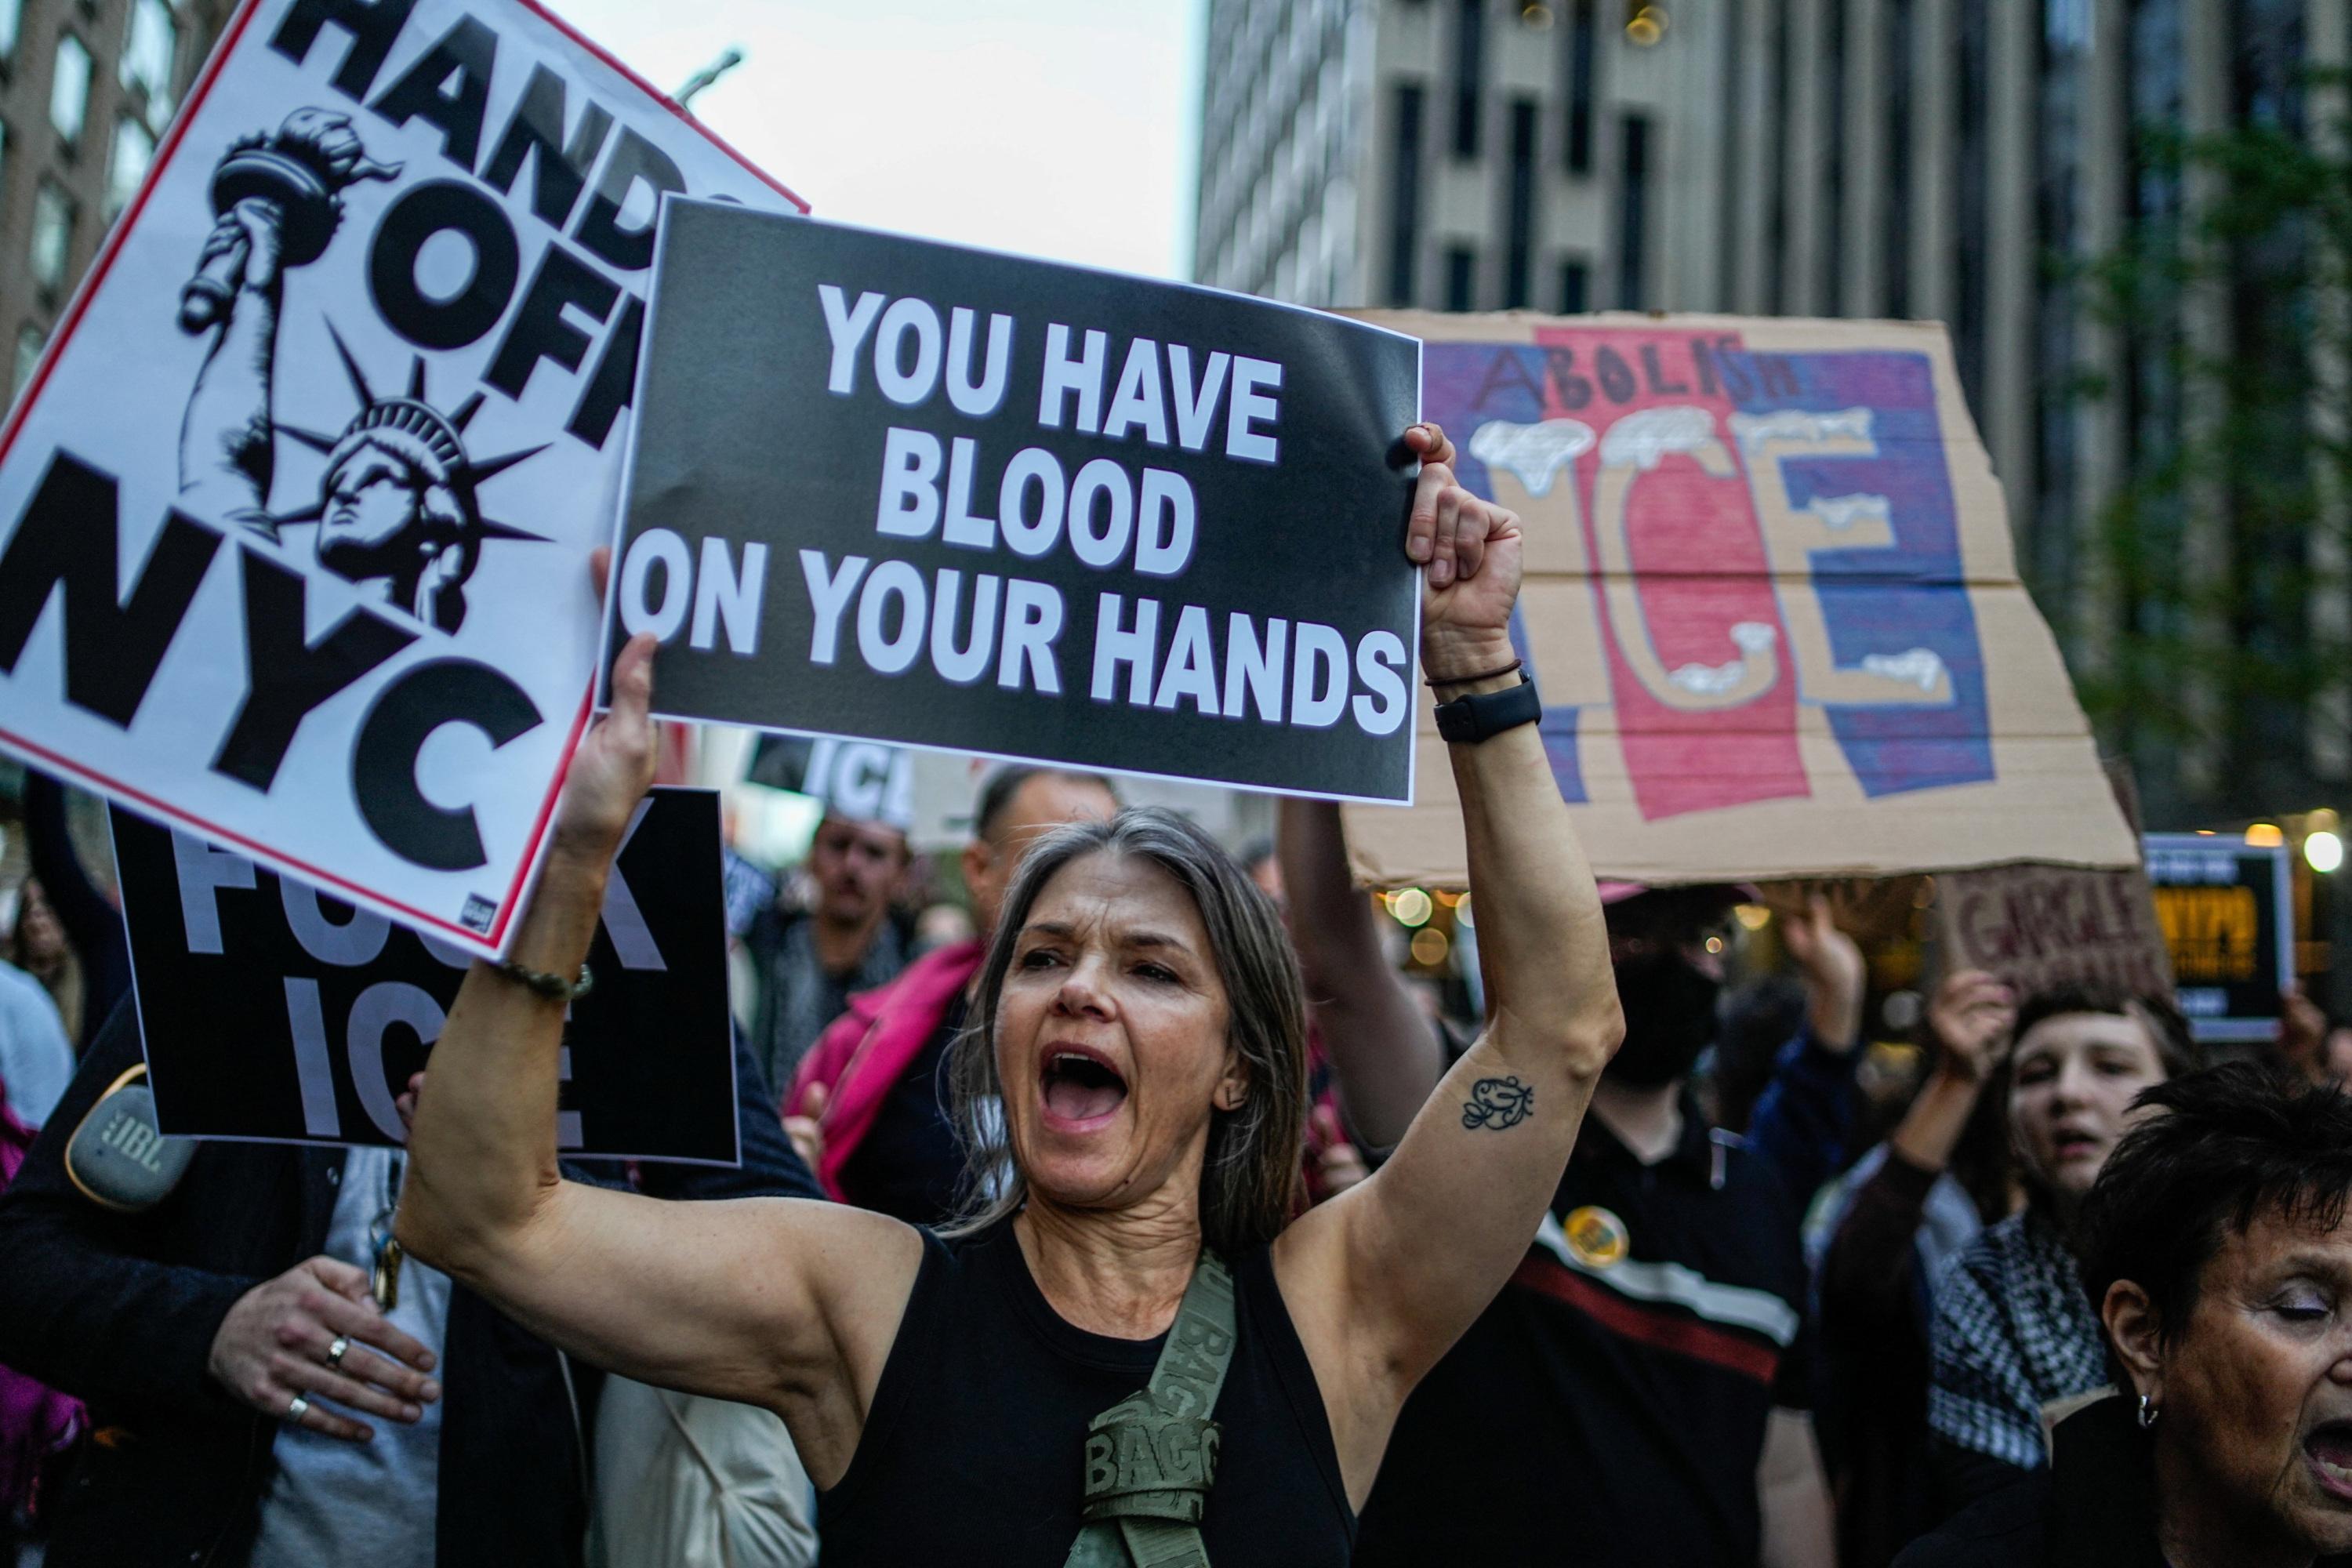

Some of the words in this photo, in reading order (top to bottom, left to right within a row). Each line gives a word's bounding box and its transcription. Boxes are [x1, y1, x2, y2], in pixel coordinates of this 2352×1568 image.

[267, 0, 743, 270] HAND
[817, 283, 1013, 416] YOU
[1037, 321, 1283, 463] HAVE
[1469, 334, 1802, 412] ABOLISH
[875, 426, 1196, 575] BLOOD
[1468, 405, 1957, 712] ICE
[0, 445, 544, 872] NYC
[619, 528, 768, 655] ON
[798, 548, 1064, 694] YOUR
[1090, 591, 1408, 736] HANDS
[169, 796, 669, 971] FK
[101, 1112, 165, 1173] JBL
[283, 976, 584, 1149] IC
